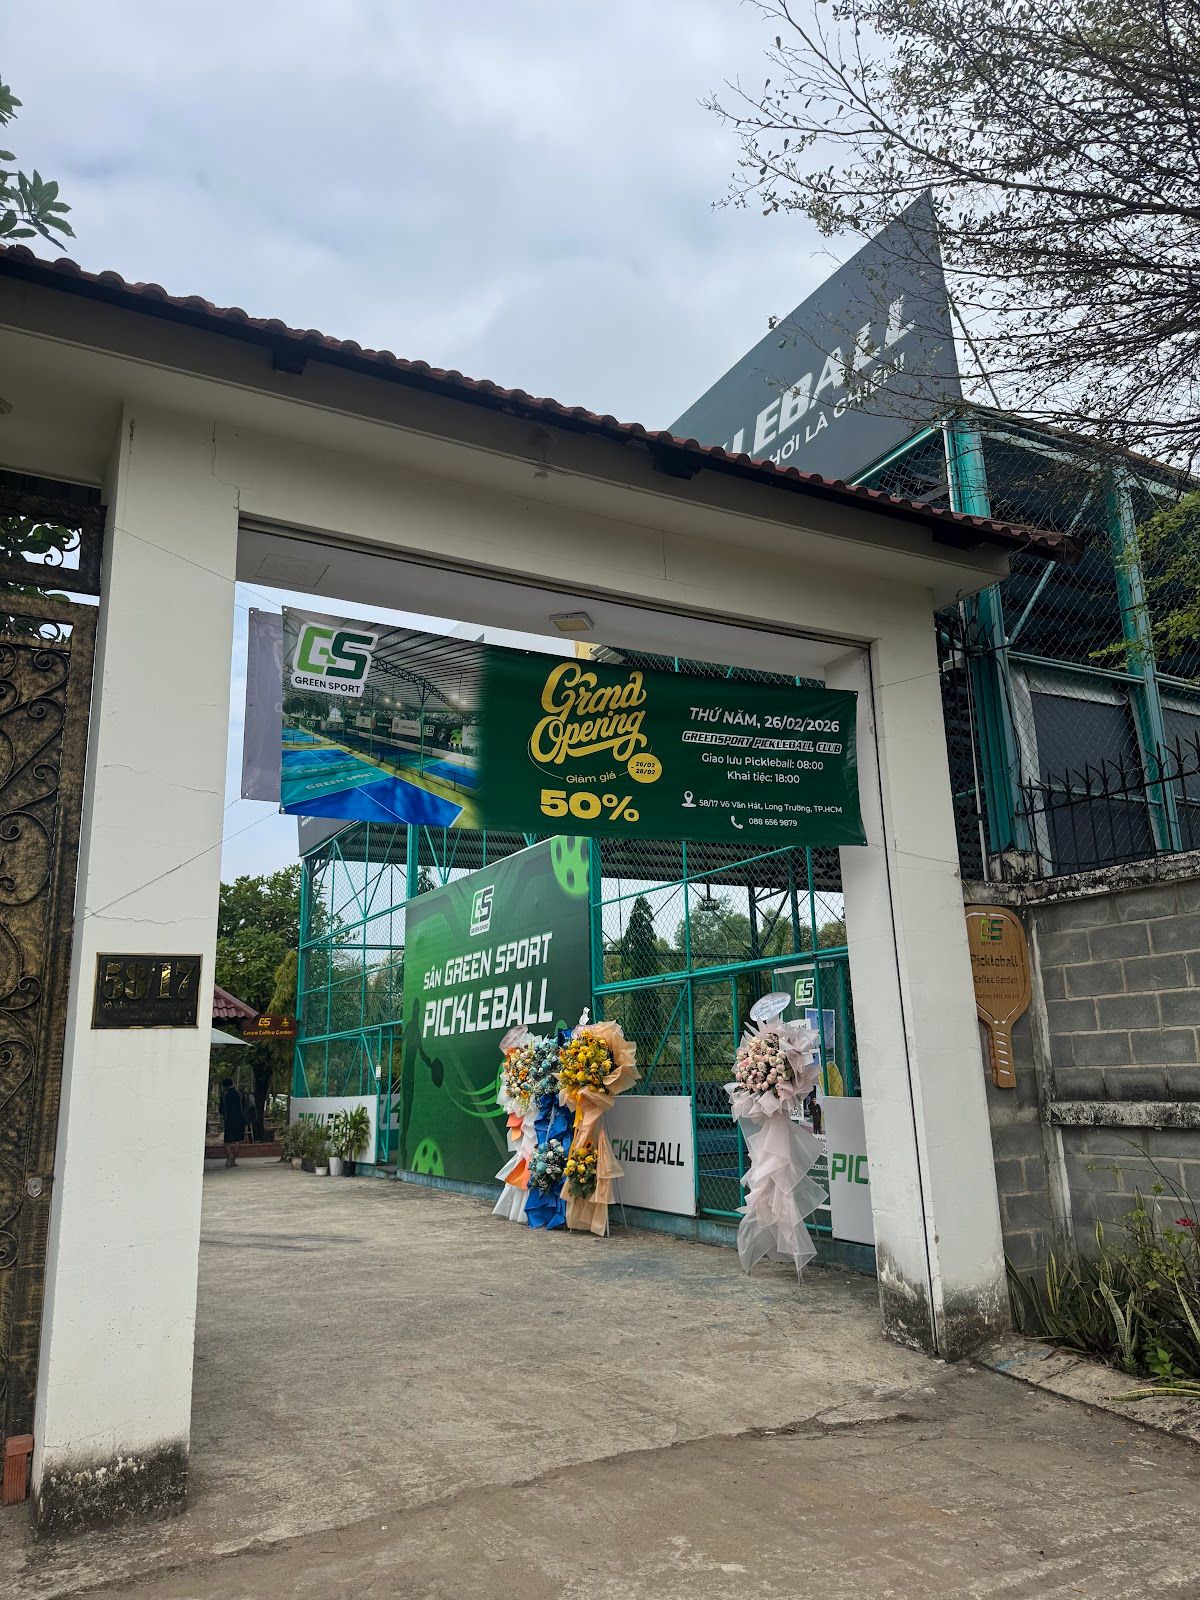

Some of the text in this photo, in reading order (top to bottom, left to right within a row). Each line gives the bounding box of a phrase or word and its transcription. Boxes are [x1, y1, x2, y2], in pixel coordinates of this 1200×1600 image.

[724, 294, 915, 457] LEBALL
[769, 433, 800, 465] HƠI
[805, 411, 828, 443] LÀ
[295, 676, 360, 694] GREEN SPORT
[541, 661, 647, 723] Grand
[690, 707, 840, 733] THỨ NĂM, 26/02/2026
[531, 710, 648, 765] Opening
[682, 731, 843, 754] GREENSPORT PICKLEBALL CLUB
[701, 753, 824, 771] Giao lưu Pickleball: 08:00
[600, 771, 616, 783] giá
[727, 771, 800, 784] Khai tiệc: 18:00
[540, 789, 640, 822] 50%
[699, 799, 719, 808] 58/17
[720, 800, 730, 808] Võ
[732, 801, 746, 809] Văn
[764, 803, 783, 812] Long
[814, 806, 843, 814] TP.HCM
[748, 817, 763, 825] 088
[423, 931, 552, 991] SÂN GREEN SPORT
[423, 977, 553, 1038] PICKLEBALL
[612, 1139, 685, 1166] CKLEBALL
[831, 1153, 869, 1184] PIC
